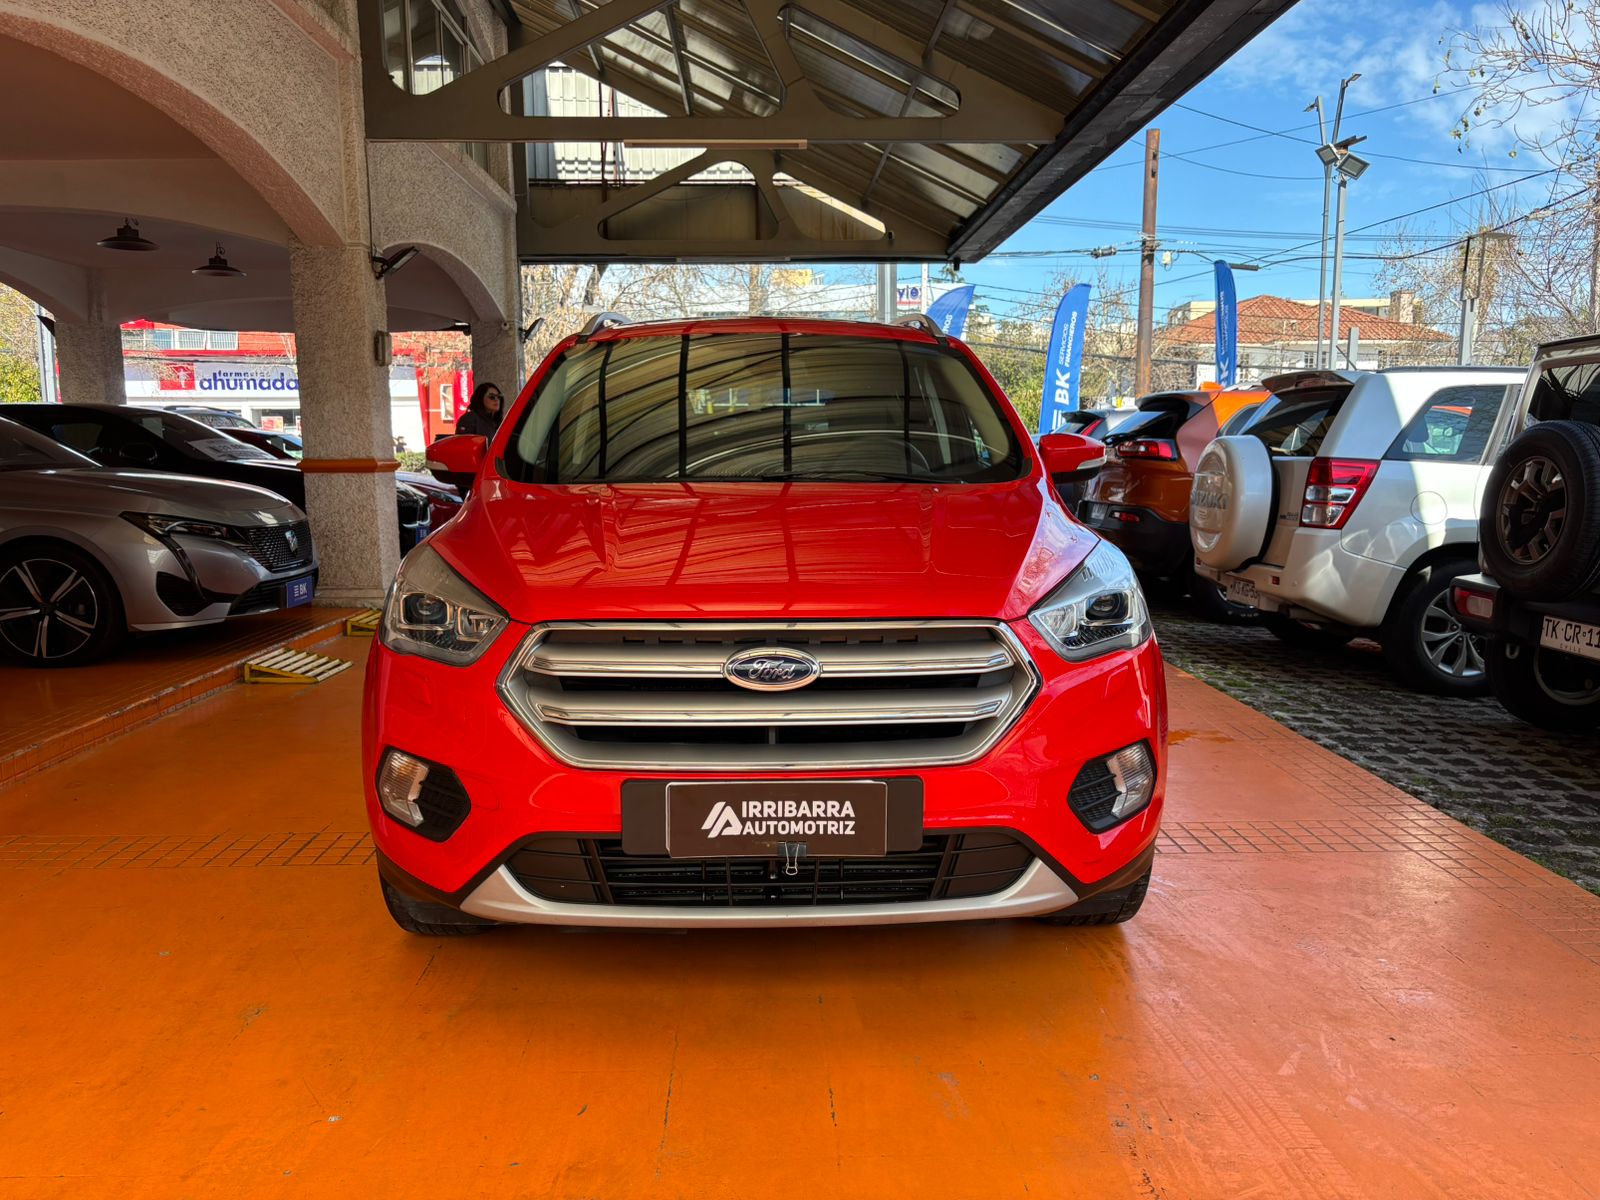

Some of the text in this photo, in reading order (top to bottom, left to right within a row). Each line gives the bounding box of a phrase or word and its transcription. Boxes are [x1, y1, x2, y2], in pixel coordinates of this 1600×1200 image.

[1059, 323, 1069, 366] SERVICIOS
[1064, 311, 1078, 368] FINANCIEROS
[199, 372, 299, 391] ahumada
[1054, 368, 1071, 405] BK
[747, 659, 796, 680] Ford
[741, 800, 856, 818] IRRIBARRA
[741, 820, 856, 836] AUTOMOTRIZ
